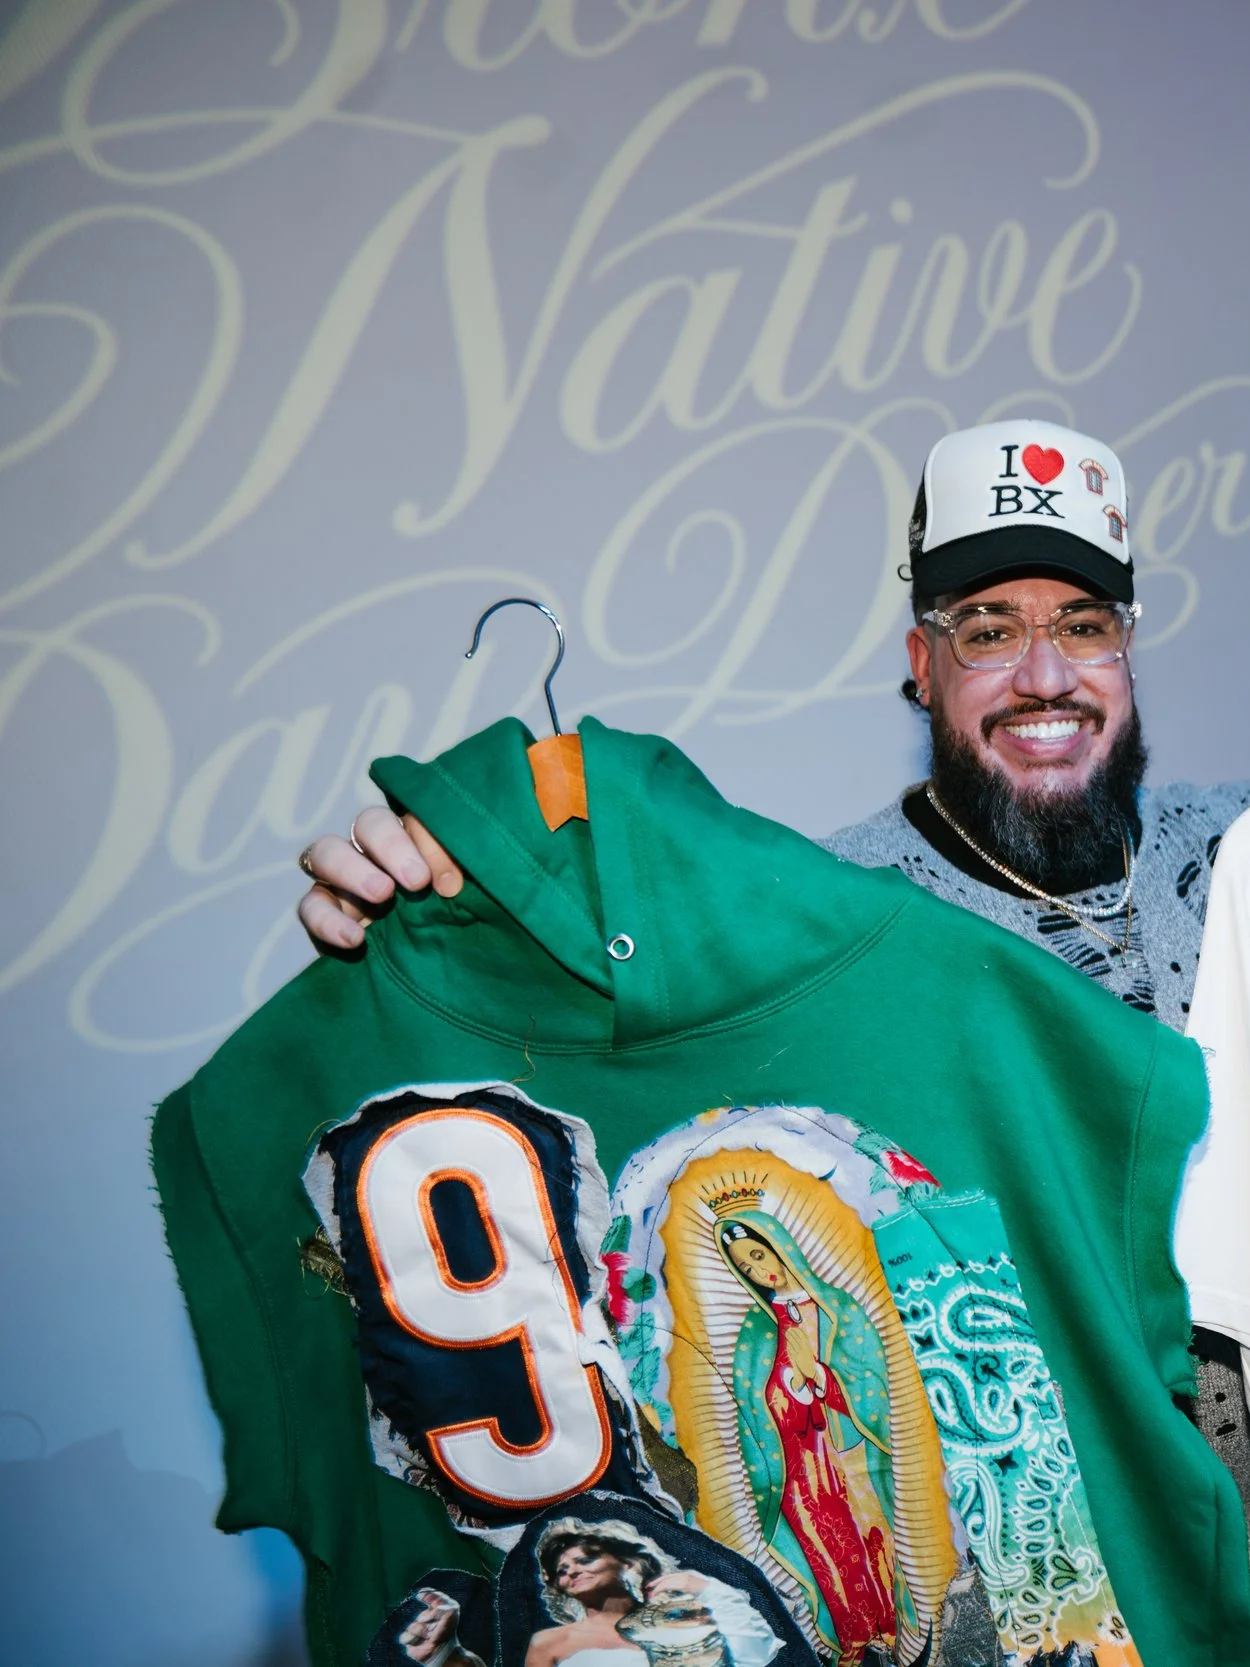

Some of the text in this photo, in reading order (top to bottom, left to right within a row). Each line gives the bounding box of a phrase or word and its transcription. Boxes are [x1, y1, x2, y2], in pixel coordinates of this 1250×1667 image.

[122, 66, 1143, 570] Native
[988, 485, 1066, 519] BX
[998, 444, 1020, 478] I
[357, 1108, 613, 1508] 9
